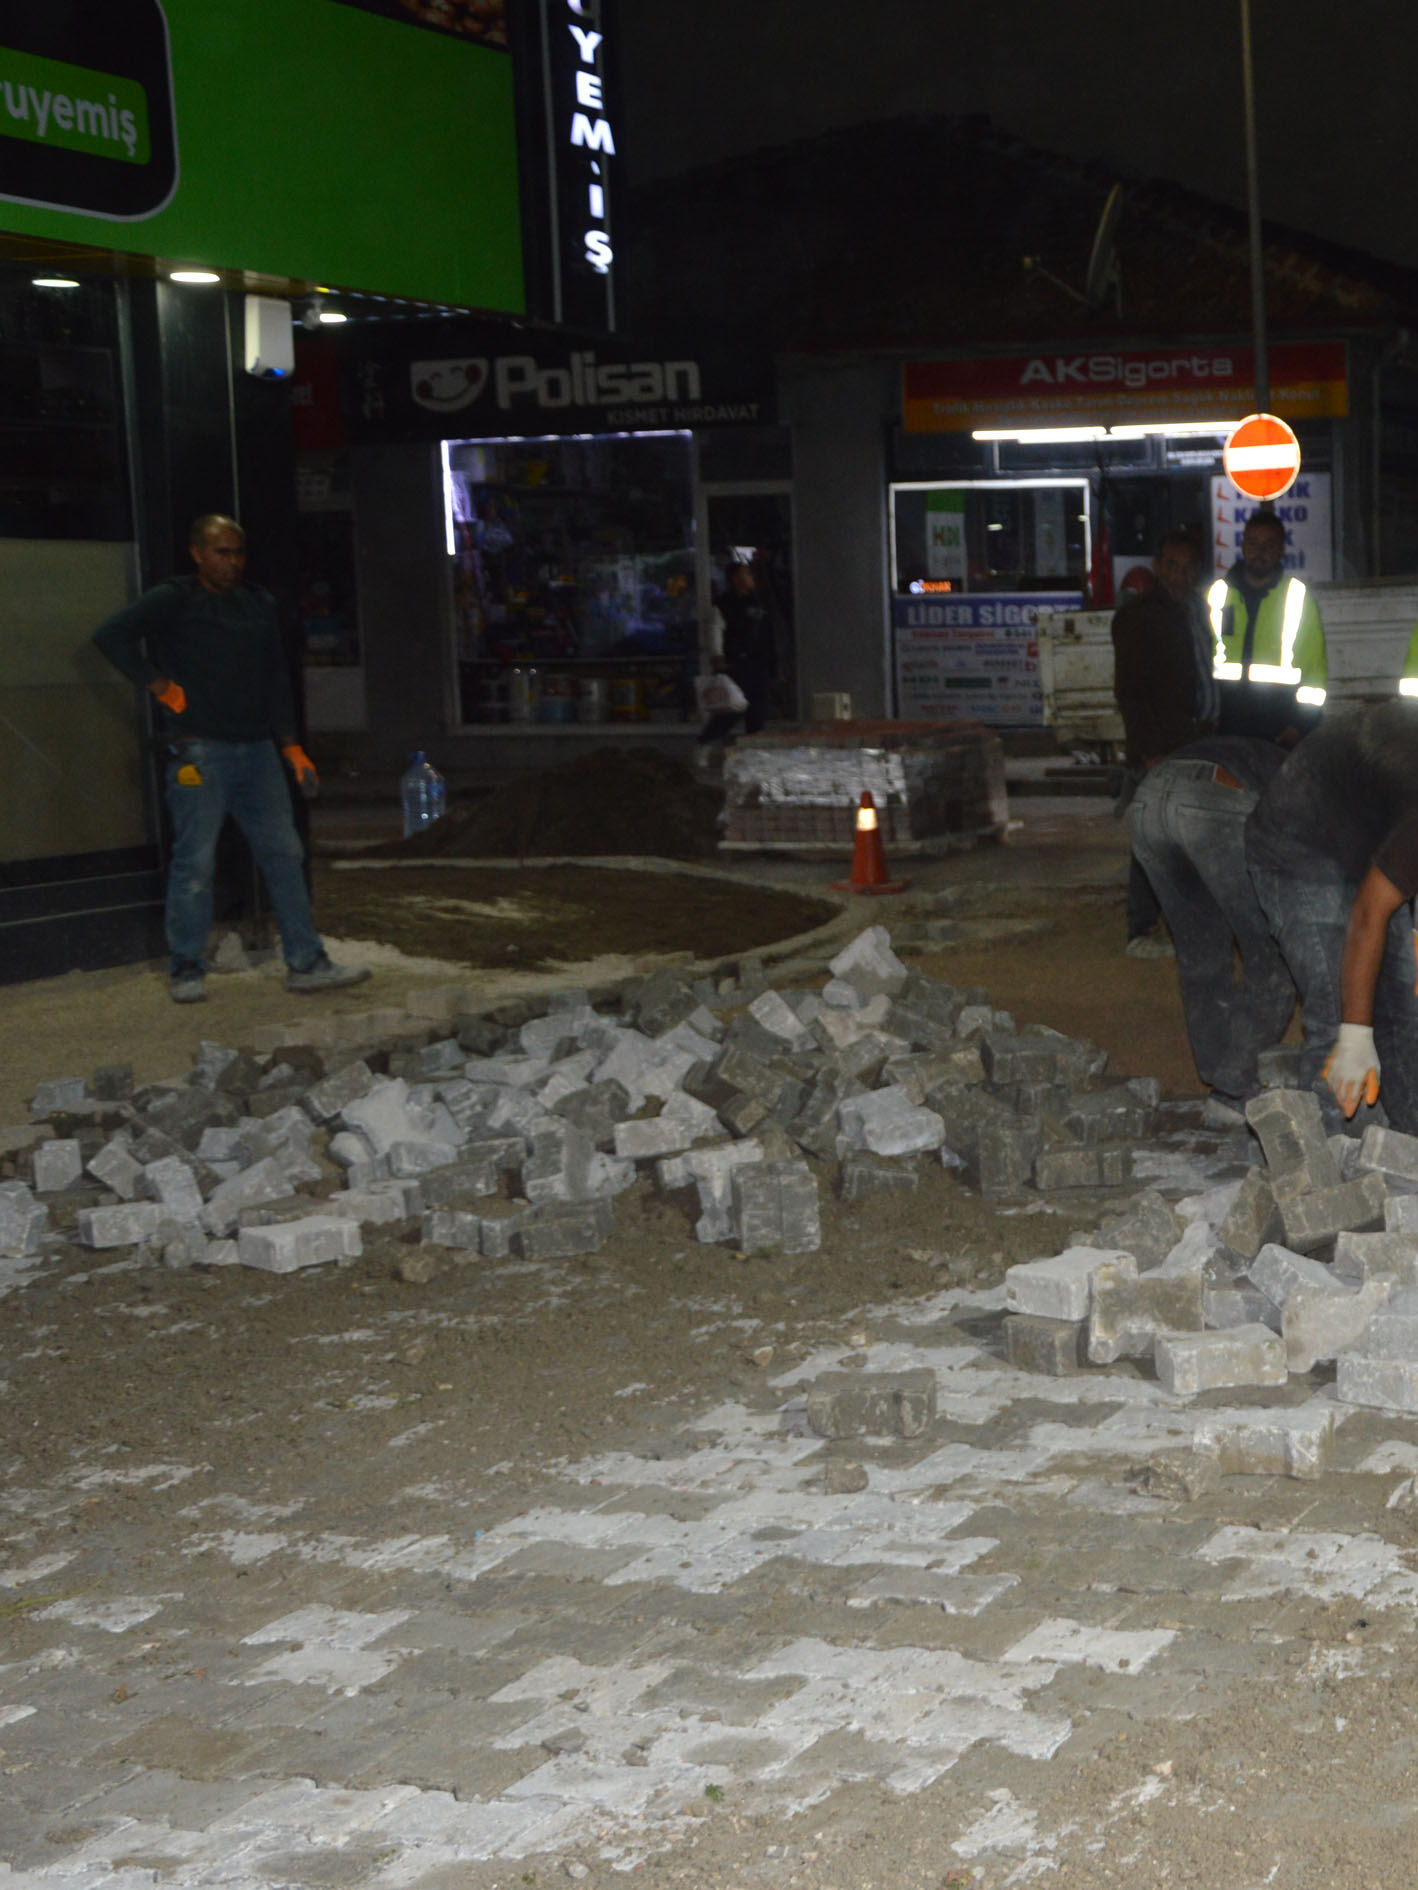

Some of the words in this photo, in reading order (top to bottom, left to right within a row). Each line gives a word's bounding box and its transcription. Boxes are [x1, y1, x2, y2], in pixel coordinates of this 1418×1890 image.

[0, 80, 138, 157] uyemiş
[495, 350, 700, 410] Polisan
[1019, 355, 1233, 388] AKSigorta
[906, 602, 973, 626] LİDER
